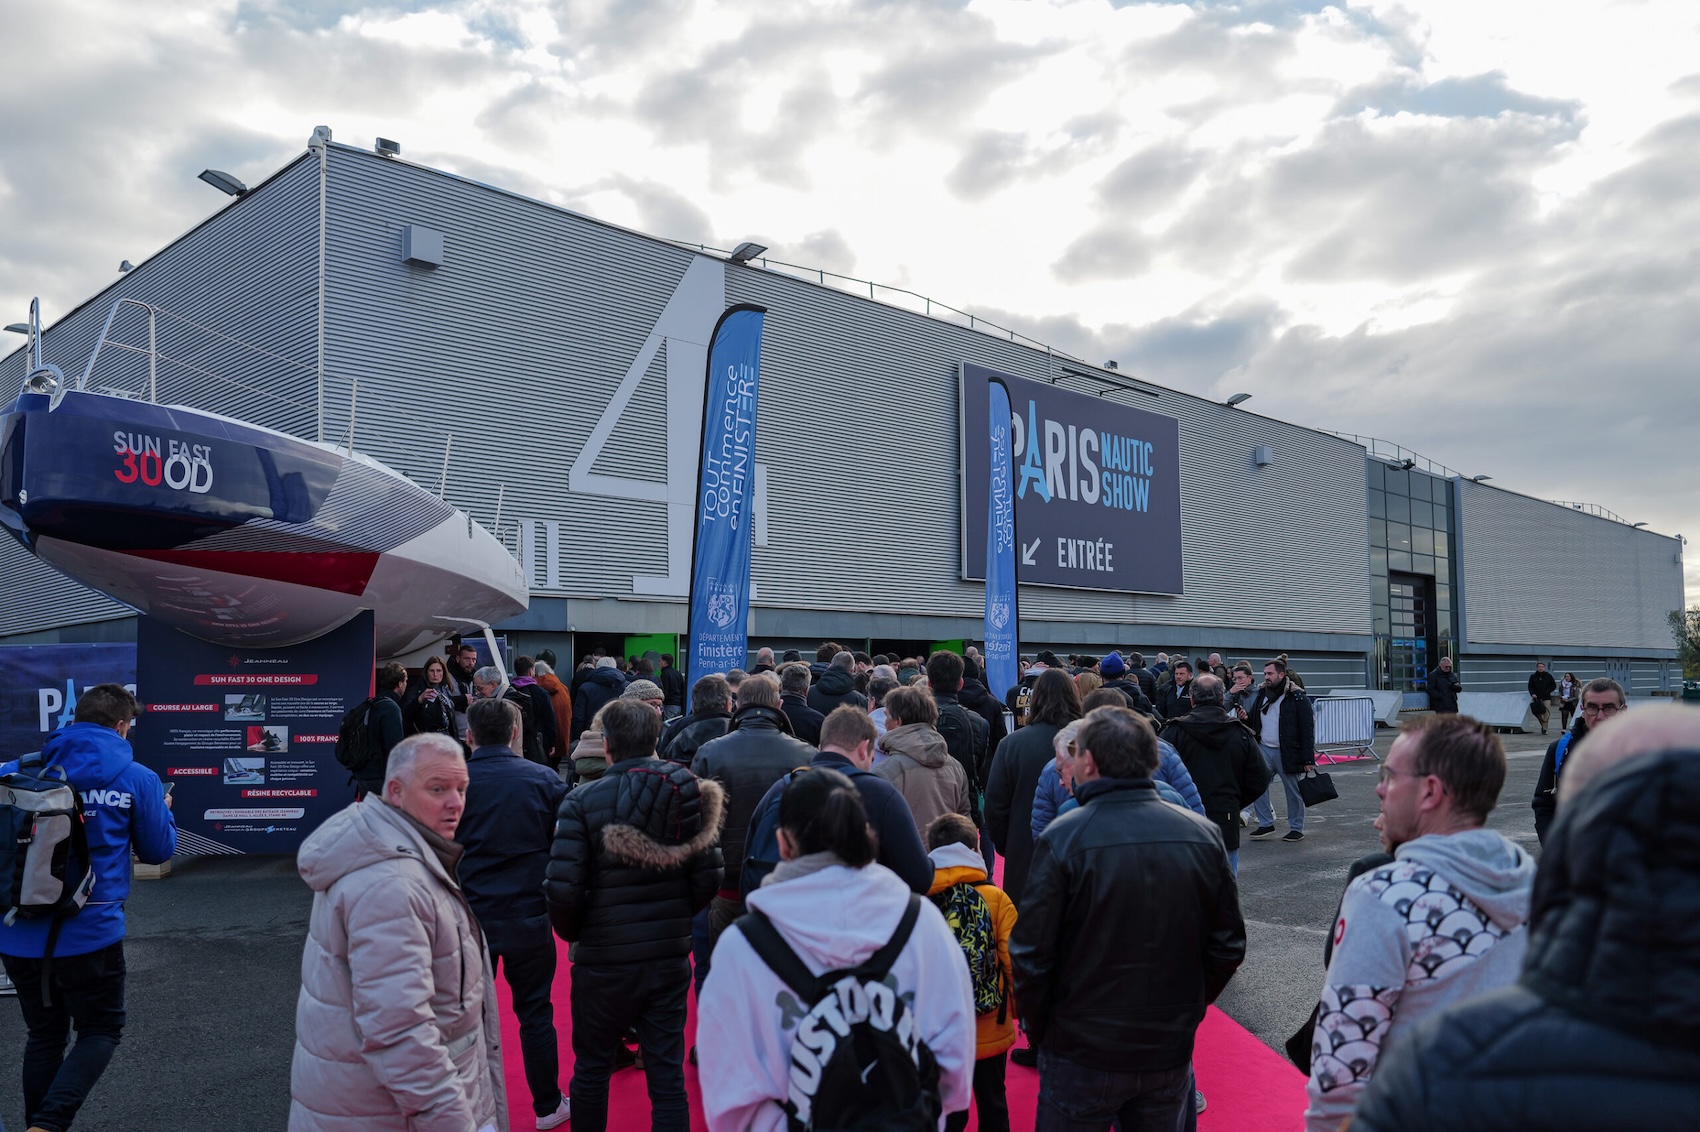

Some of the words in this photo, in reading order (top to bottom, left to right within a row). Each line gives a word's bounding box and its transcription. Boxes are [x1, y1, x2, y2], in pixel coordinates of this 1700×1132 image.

[113, 430, 161, 458] SUN
[168, 439, 212, 466] FAST
[1100, 432, 1153, 477] NAUTIC
[702, 451, 721, 526] TOUT
[1102, 471, 1150, 513] SHOW
[1058, 537, 1114, 572] ENTRÉE
[699, 631, 743, 642] DÉPARTEMENT
[316, 735, 339, 744] FRANÇ
[247, 789, 271, 797] RÉSINE
[271, 789, 312, 797] RECYCLABLE
[788, 992, 851, 1124] JUST
